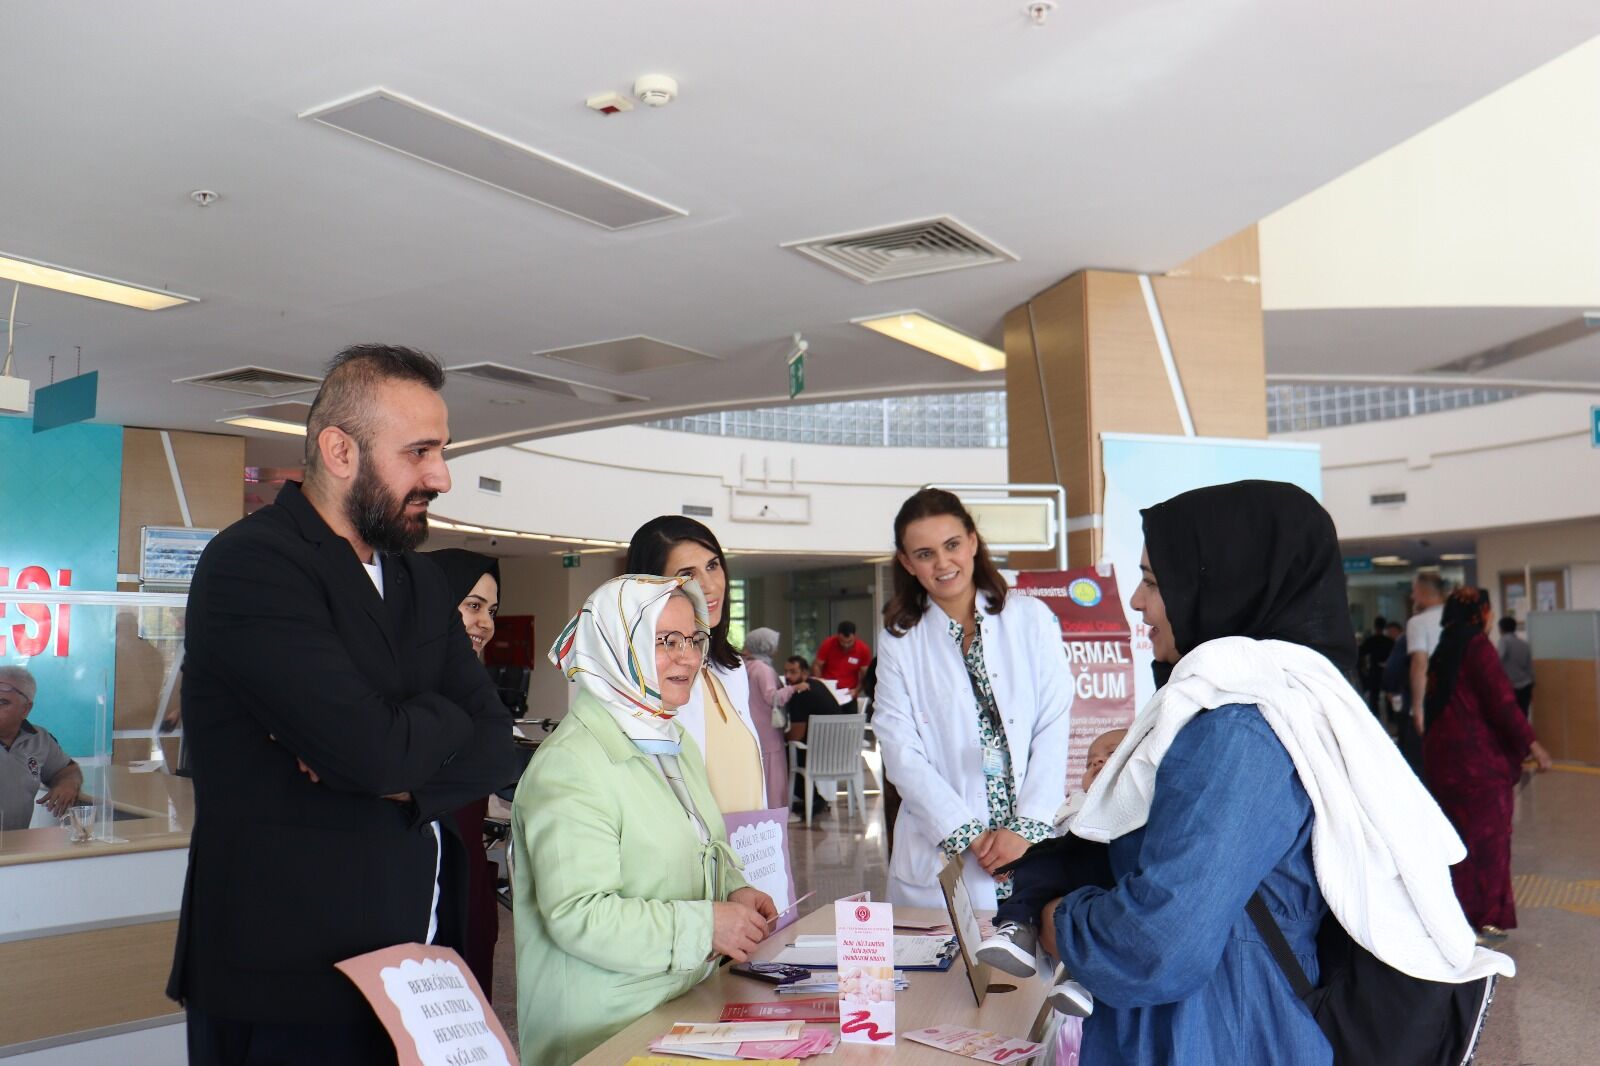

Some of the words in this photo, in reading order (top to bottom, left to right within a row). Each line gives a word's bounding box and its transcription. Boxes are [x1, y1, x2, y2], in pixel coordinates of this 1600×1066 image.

[1063, 640, 1129, 664] ORMAL
[1073, 666, 1125, 699] ĞUM
[421, 999, 474, 1020] HAYATINIZA
[433, 1023, 468, 1044] HEMEN
